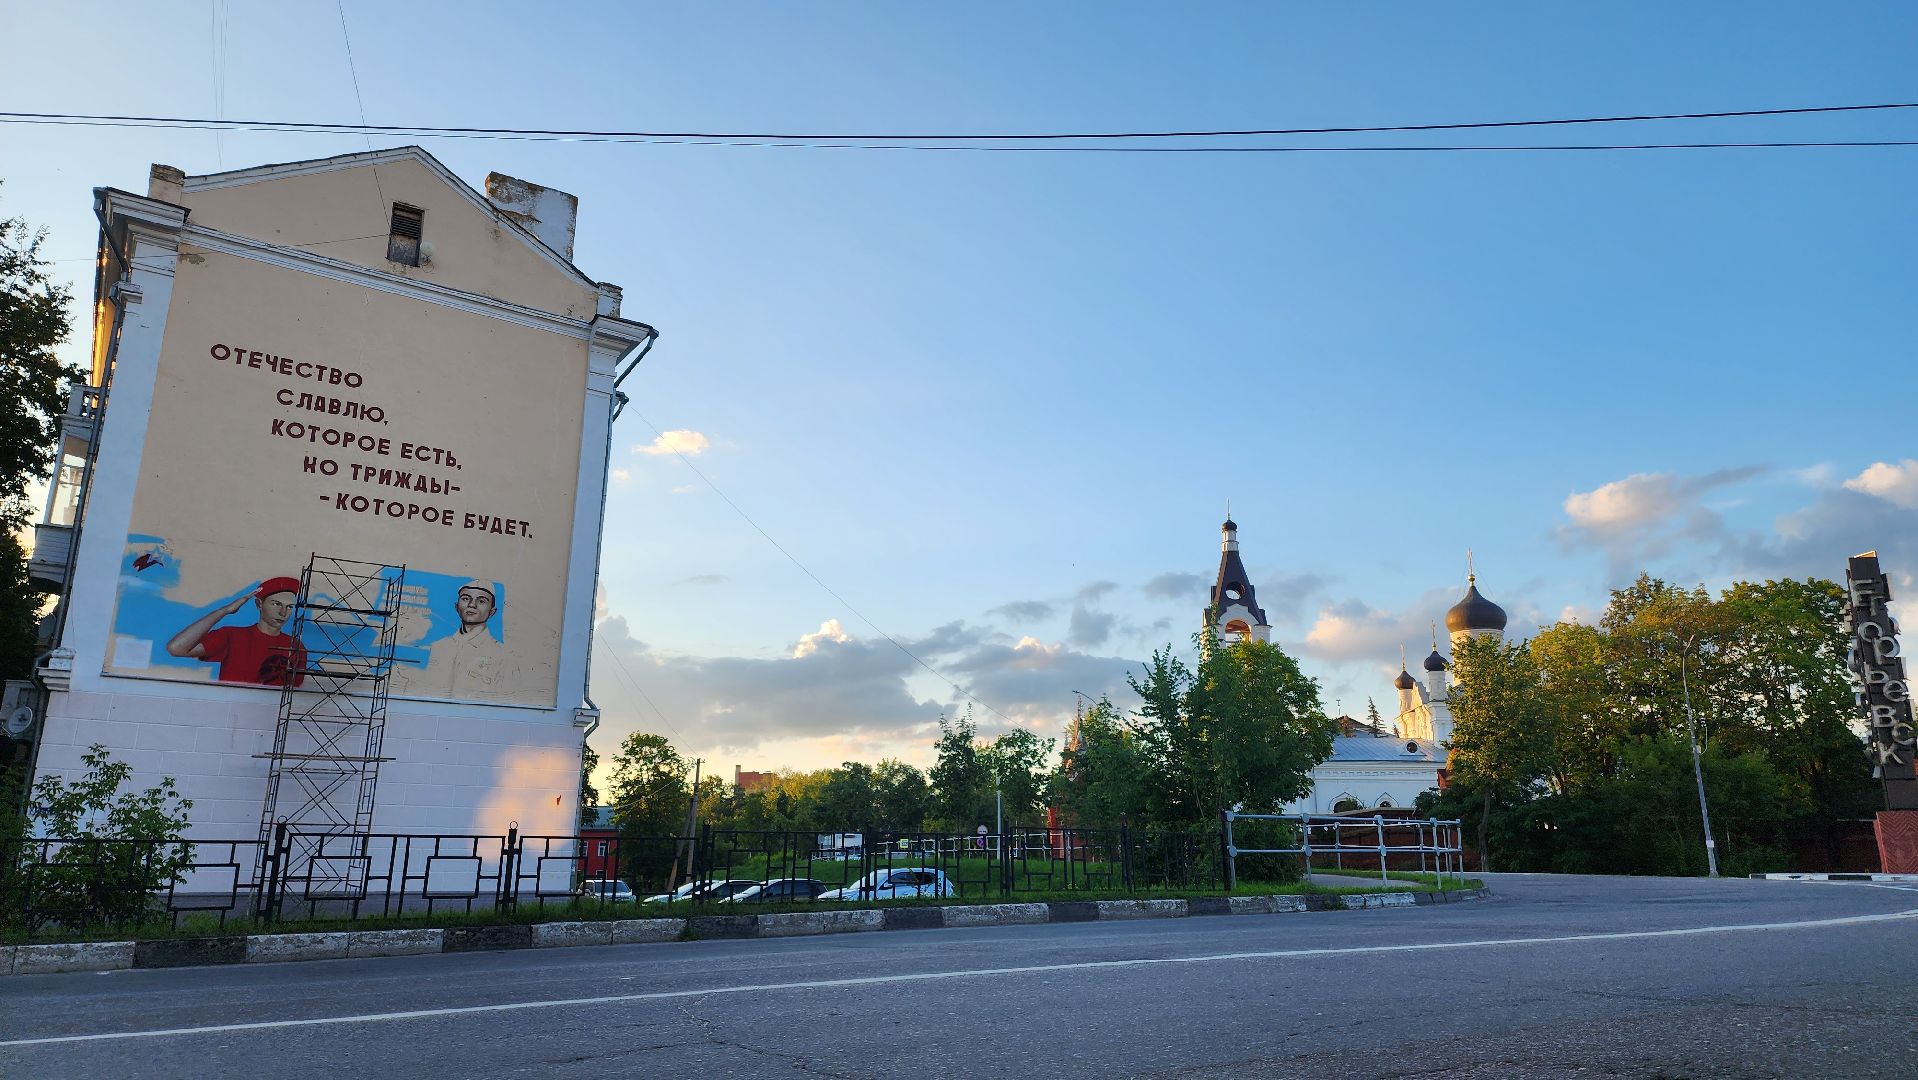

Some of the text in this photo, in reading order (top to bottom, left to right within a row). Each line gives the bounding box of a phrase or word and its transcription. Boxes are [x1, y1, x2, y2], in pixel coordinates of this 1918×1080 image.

[210, 343, 363, 389] ОТЕЧЕСТВО
[276, 388, 389, 427] СЛАВЛЮ,
[271, 418, 463, 471] КОТОРОЕ ЕСТЬ,
[303, 455, 339, 476] НО
[463, 512, 534, 539] БУДЕТ.
